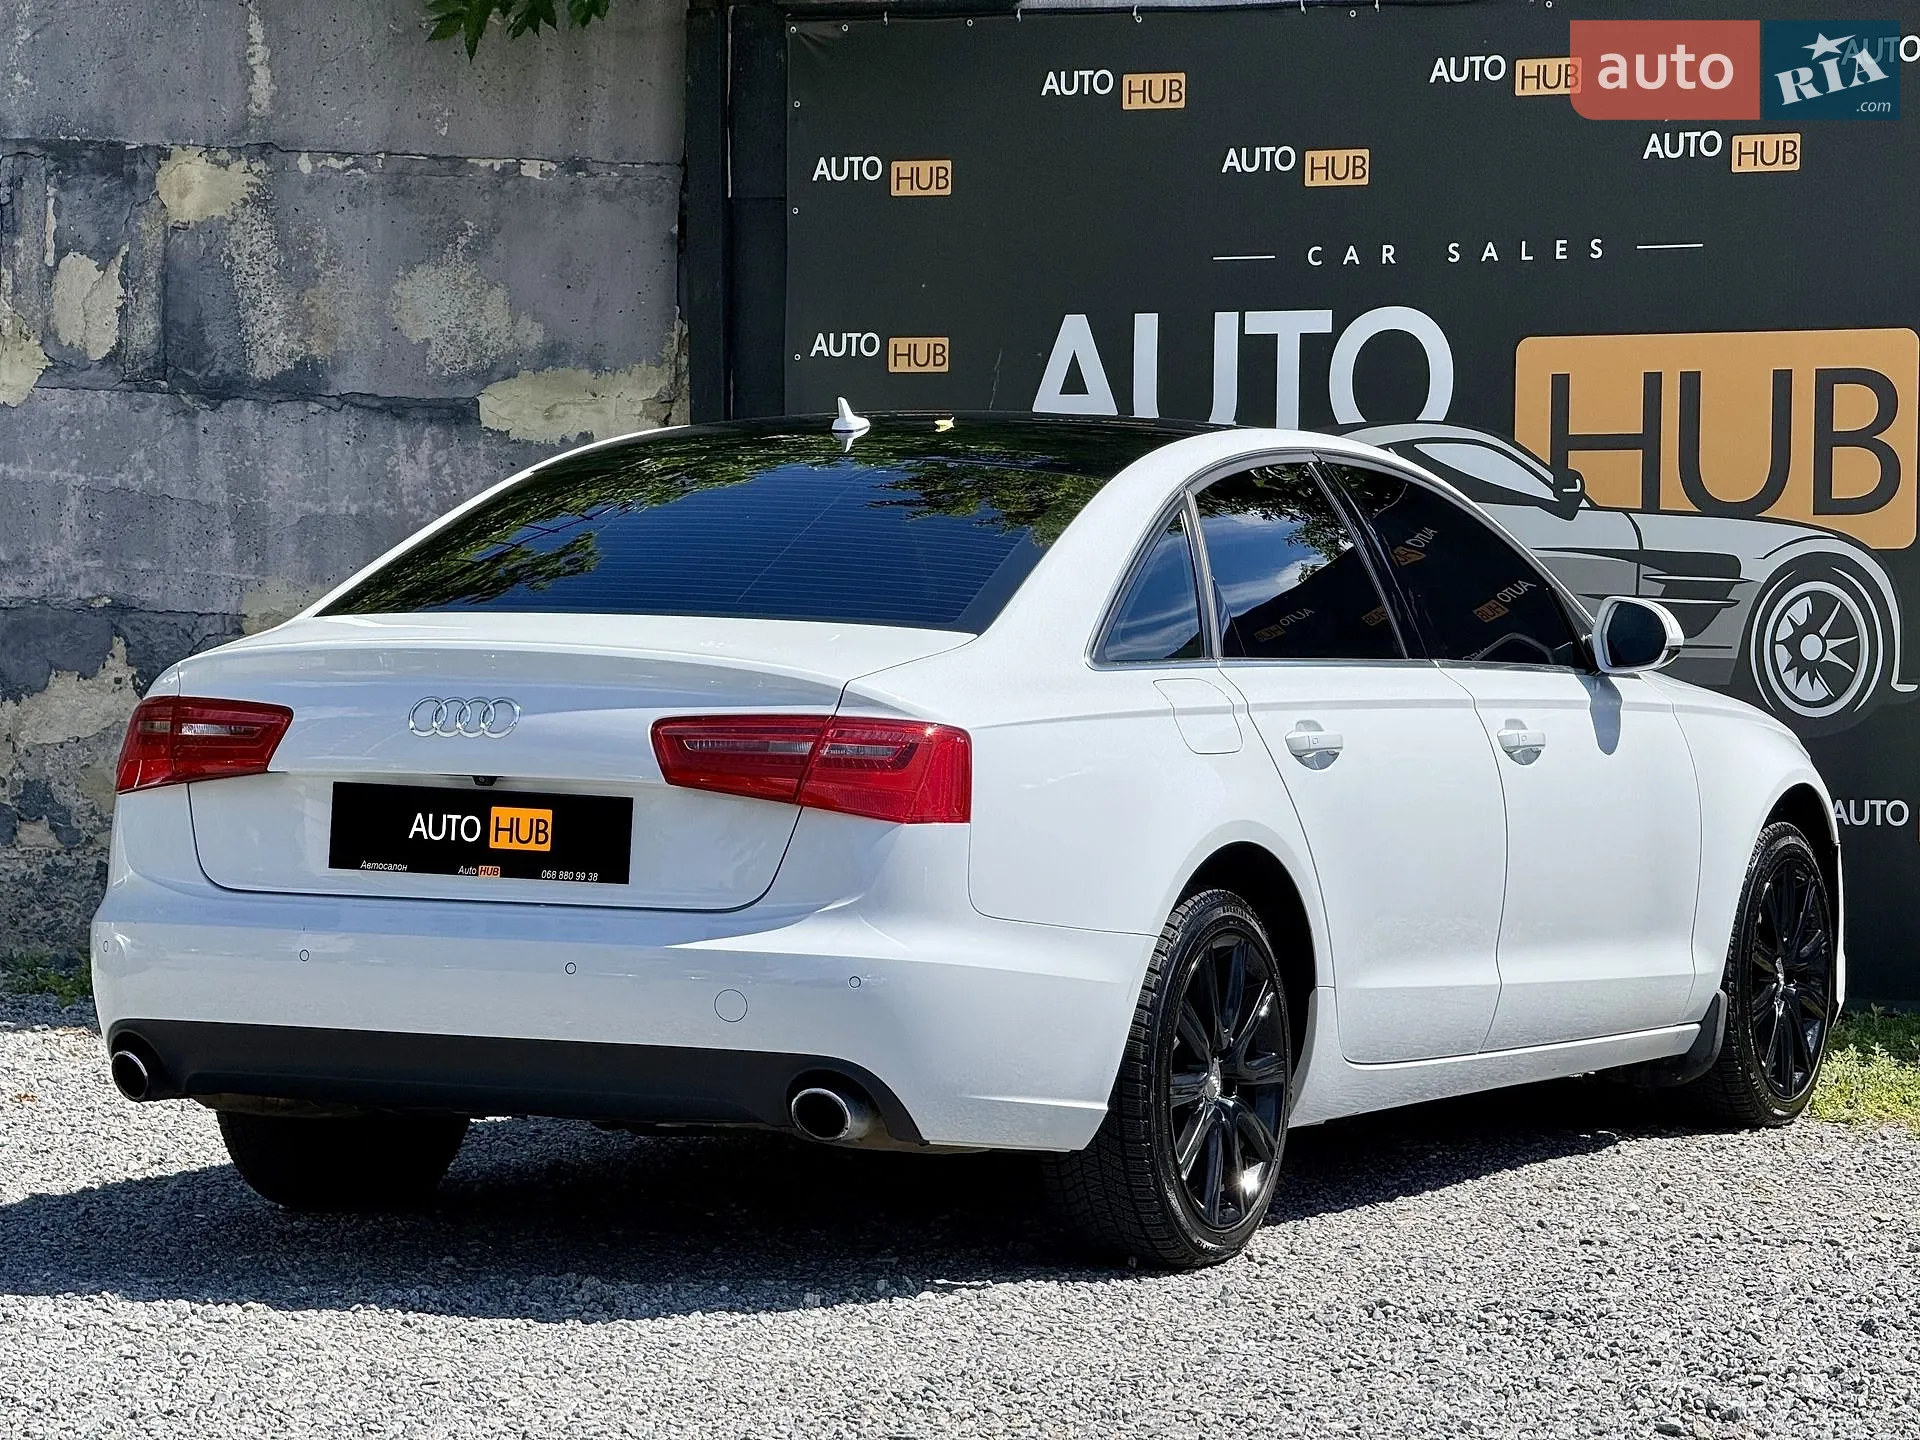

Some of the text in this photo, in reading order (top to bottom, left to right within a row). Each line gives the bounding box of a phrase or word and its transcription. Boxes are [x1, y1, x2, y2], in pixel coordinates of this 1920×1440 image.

[1041, 69, 1184, 105] AUTO HUB
[1429, 54, 1579, 91] AUTO HUB
[1222, 145, 1367, 182] AUTO HUB
[1643, 130, 1798, 167] AUTO HUB
[812, 155, 950, 191] AUTO HUB
[1307, 238, 1603, 266] CAR SALES
[810, 332, 947, 368] AUTO HUB
[1031, 305, 1902, 517] AUTO HUB
[408, 812, 550, 846] AUTO HUB
[1834, 799, 1910, 827] AUTO
[458, 865, 500, 876] Auto HUB
[541, 869, 599, 881] 068 880 99 38
